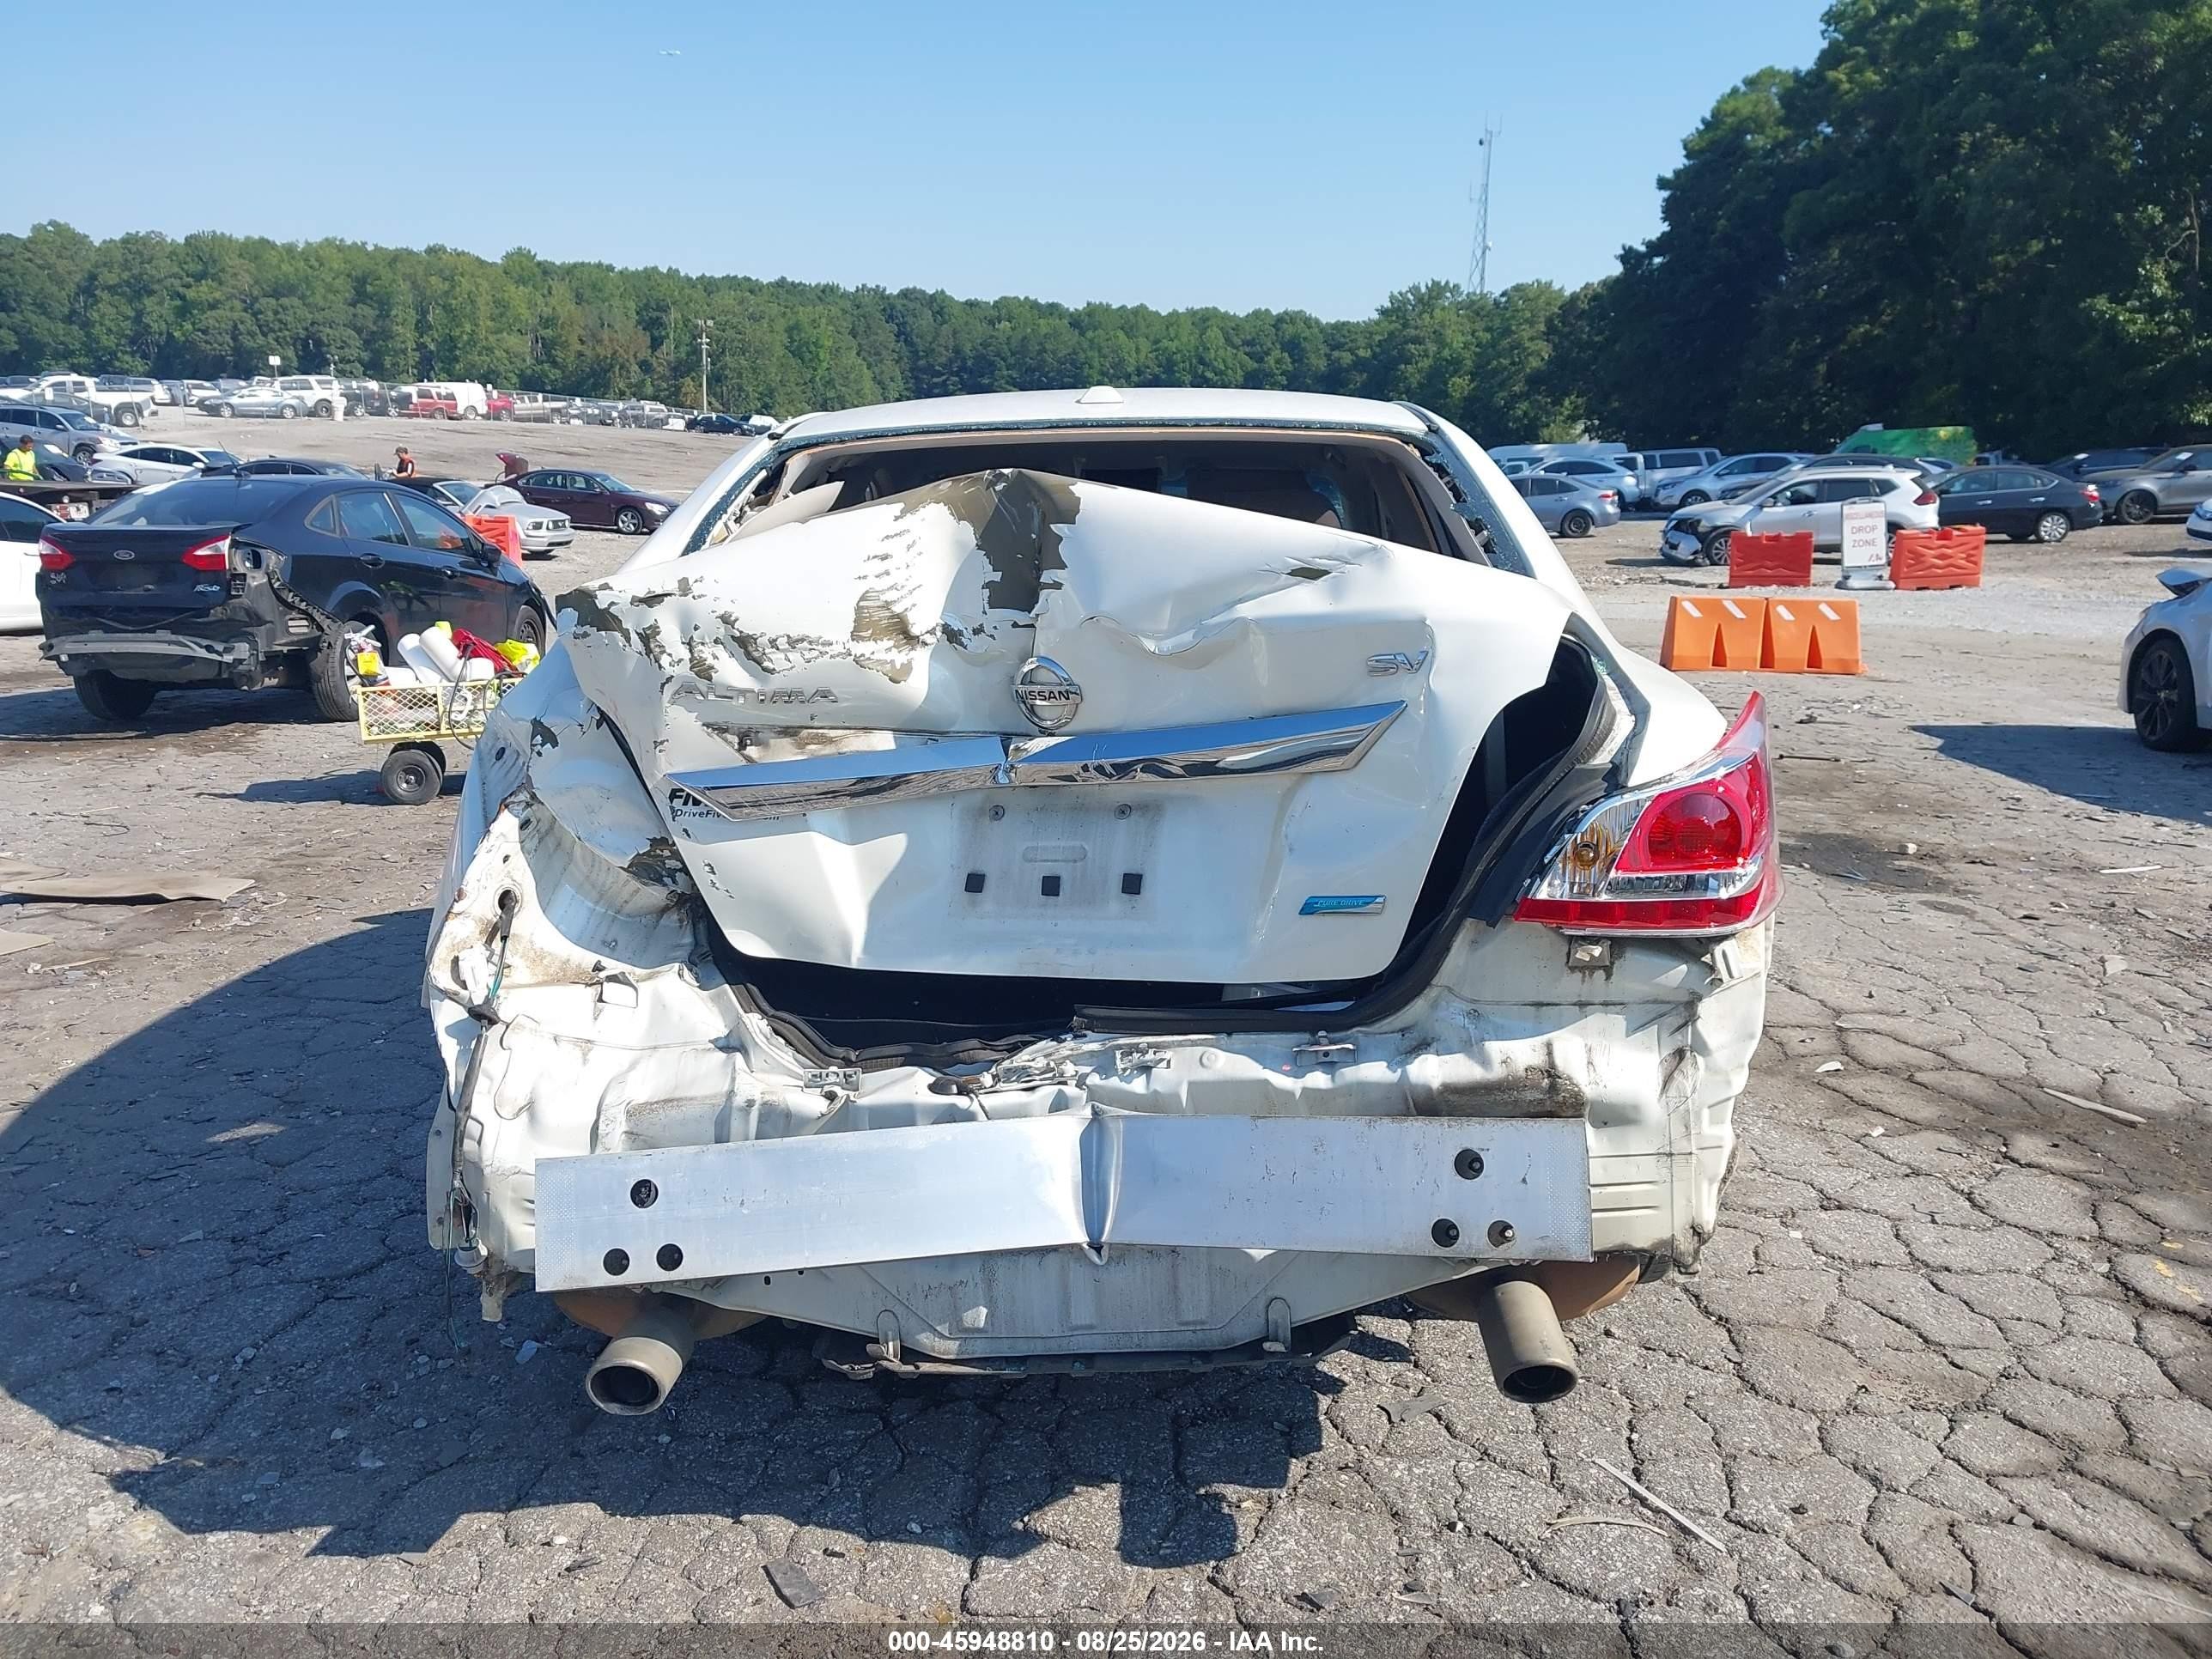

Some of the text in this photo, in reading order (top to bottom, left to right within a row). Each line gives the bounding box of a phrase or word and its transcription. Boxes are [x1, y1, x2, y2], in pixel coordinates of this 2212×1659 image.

[1850, 525, 1878, 534] DROP
[1851, 538, 1878, 548] ZONE
[1367, 651, 1429, 677] SV
[672, 681, 839, 703] ALTIMA
[1014, 690, 1071, 701] NISSAN
